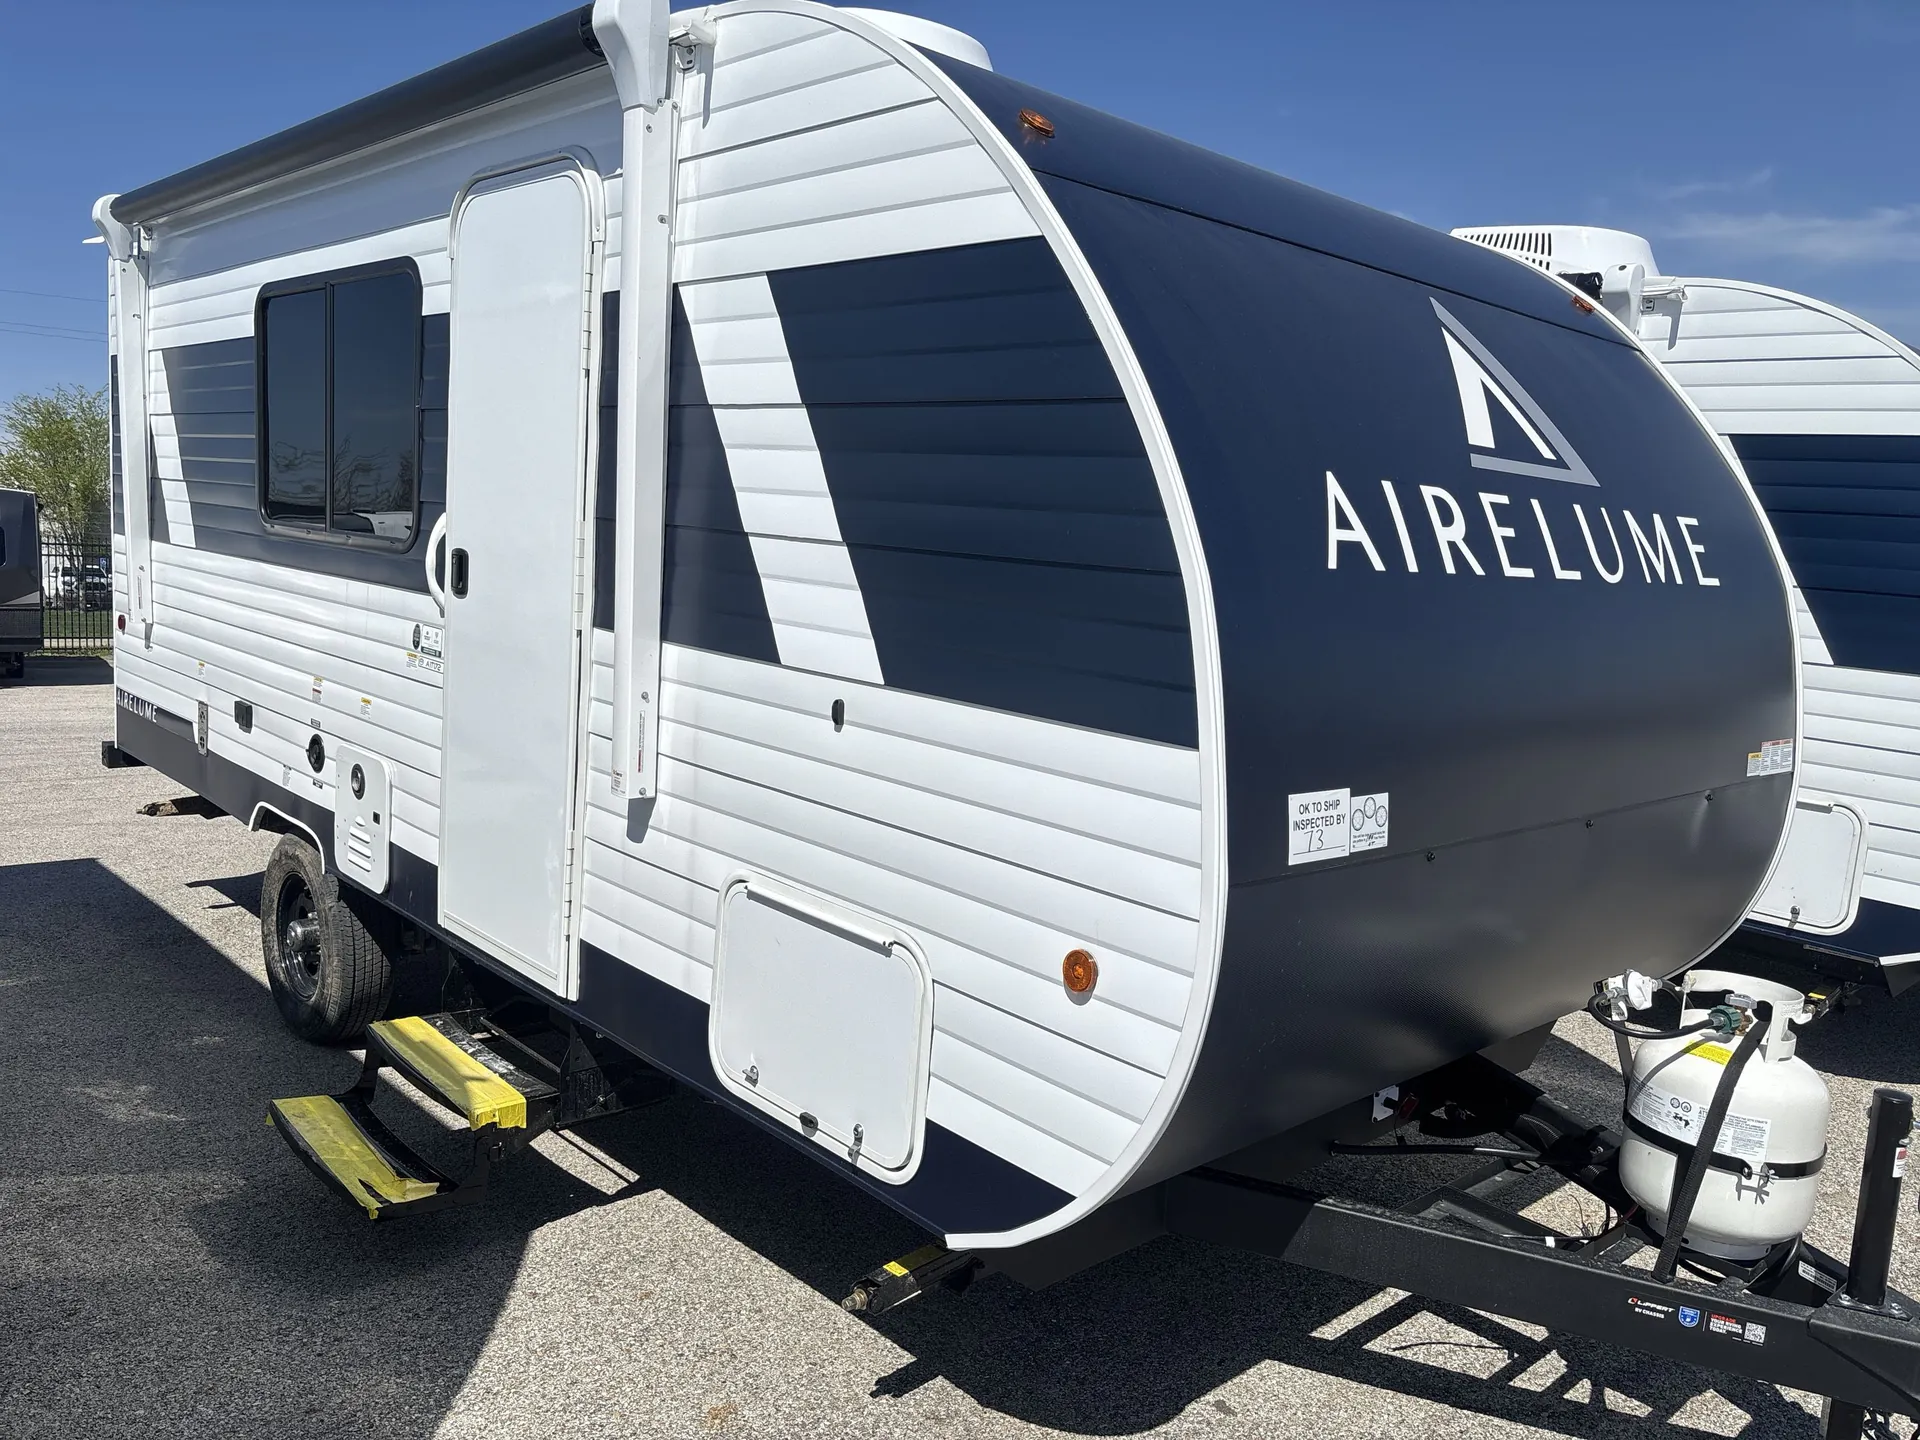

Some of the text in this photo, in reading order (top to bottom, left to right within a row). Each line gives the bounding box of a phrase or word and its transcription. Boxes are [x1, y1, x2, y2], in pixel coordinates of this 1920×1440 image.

[1325, 470, 1720, 587] AIRELUME
[116, 688, 157, 723] AIRELUME
[1298, 799, 1341, 815] OK TO SHIP
[1293, 813, 1346, 831] INSPECTED BY
